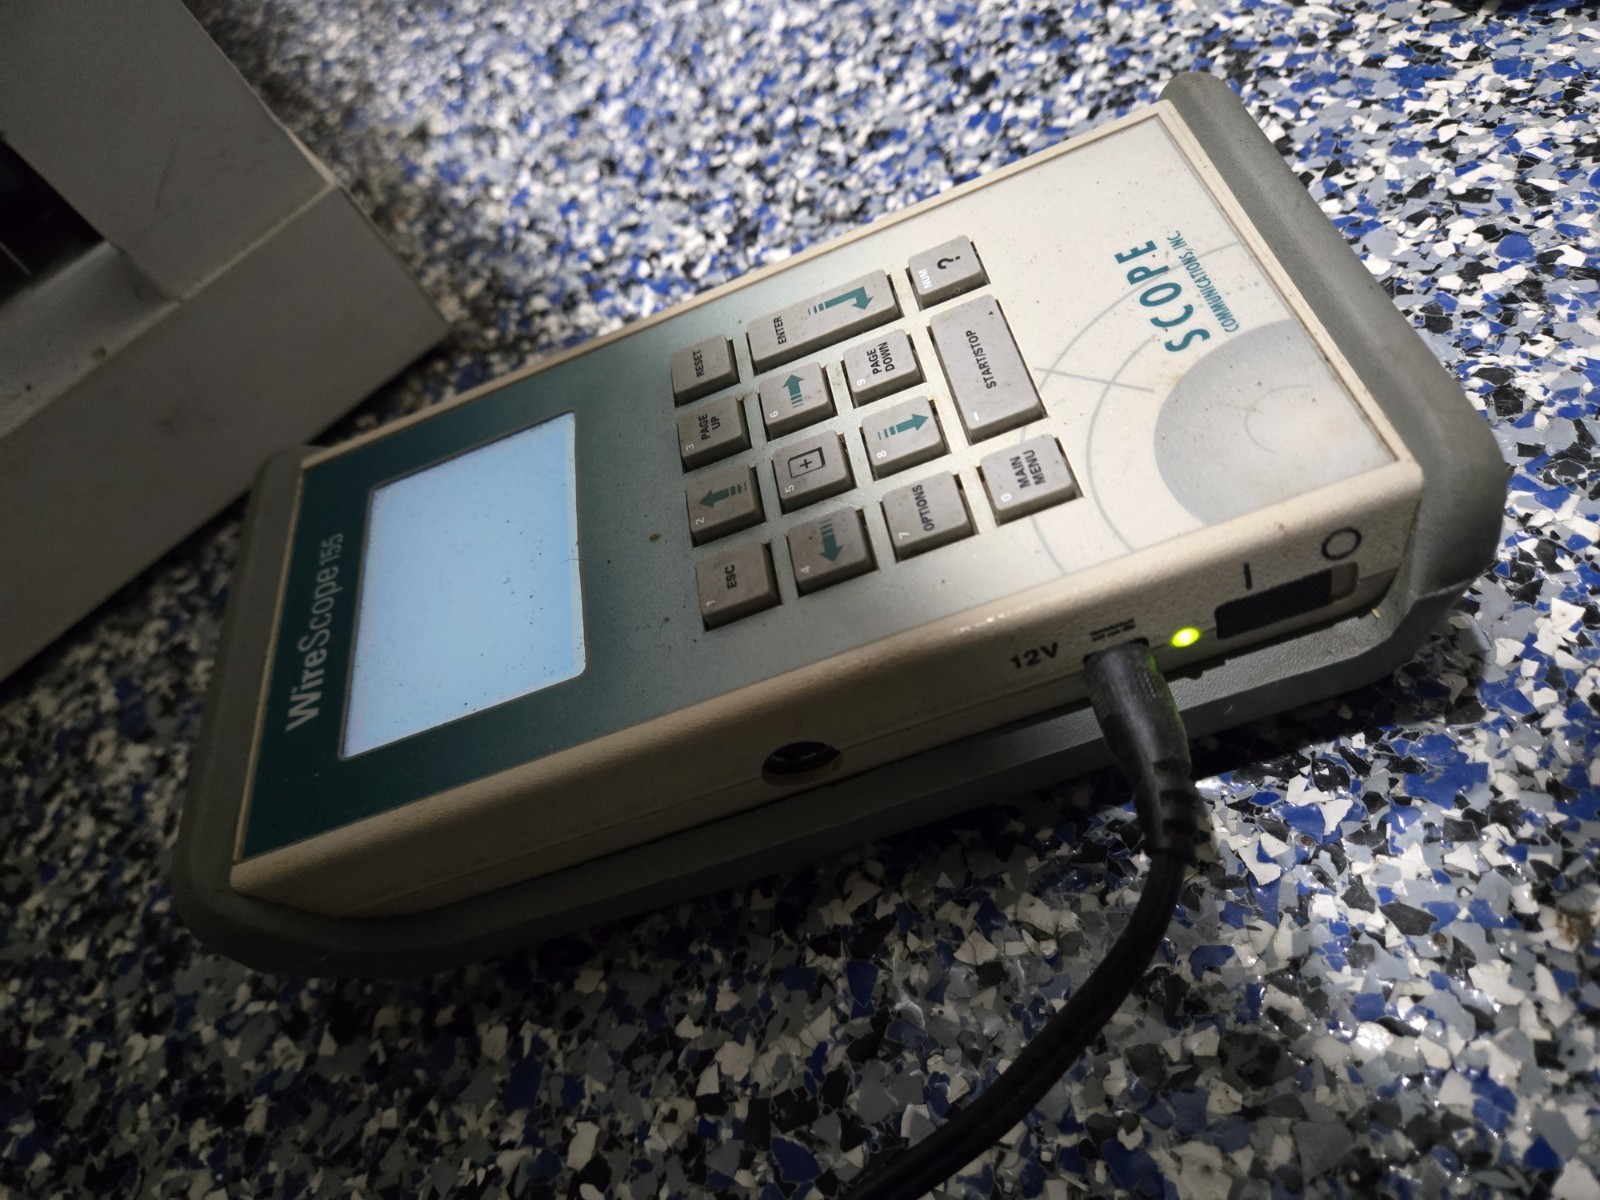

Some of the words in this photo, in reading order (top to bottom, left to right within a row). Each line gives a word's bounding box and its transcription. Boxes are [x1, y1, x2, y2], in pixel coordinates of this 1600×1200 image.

[1167, 230, 1184, 250] INC.
[919, 268, 932, 289] NUM
[1179, 248, 1239, 332] COMMUNICATIONS,
[1114, 240, 1210, 352] SCOPE
[773, 316, 787, 346] ENTER
[692, 350, 704, 378] RESET
[866, 348, 882, 375] PAGE
[878, 341, 895, 372] DOWN
[965, 329, 997, 390] START/STOP
[698, 413, 710, 441] PAGE
[710, 416, 721, 431] UP
[685, 443, 694, 451] 3
[877, 450, 887, 458] 8
[1009, 456, 1029, 489] MAIN
[1022, 449, 1046, 485] MENU
[784, 485, 795, 493] 5
[696, 517, 704, 525] 2
[912, 484, 935, 531] OPTIONS
[899, 532, 908, 540] 7
[725, 565, 737, 590] ESC
[285, 566, 343, 732] WireScope
[321, 533, 344, 565] 155
[1010, 643, 1059, 669] 12V
